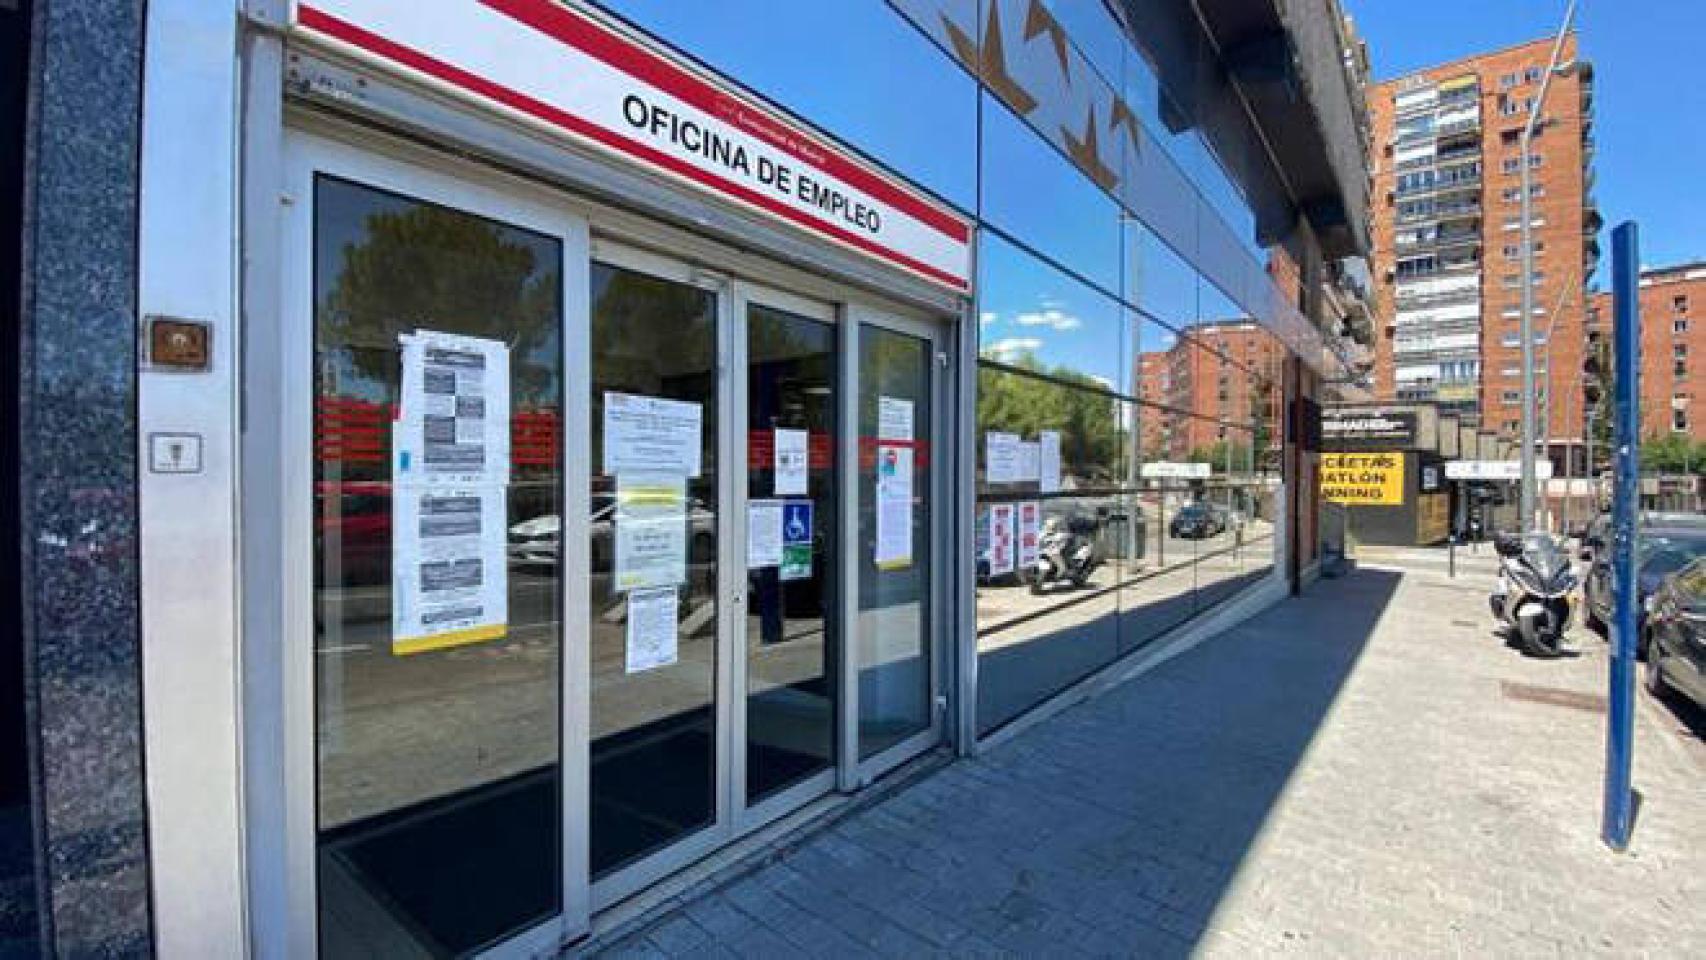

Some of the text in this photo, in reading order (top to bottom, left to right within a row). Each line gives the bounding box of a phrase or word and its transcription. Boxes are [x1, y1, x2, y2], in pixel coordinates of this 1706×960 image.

[623, 95, 750, 176] OFICINA
[757, 155, 792, 194] DE
[798, 175, 881, 233] EMPLEO
